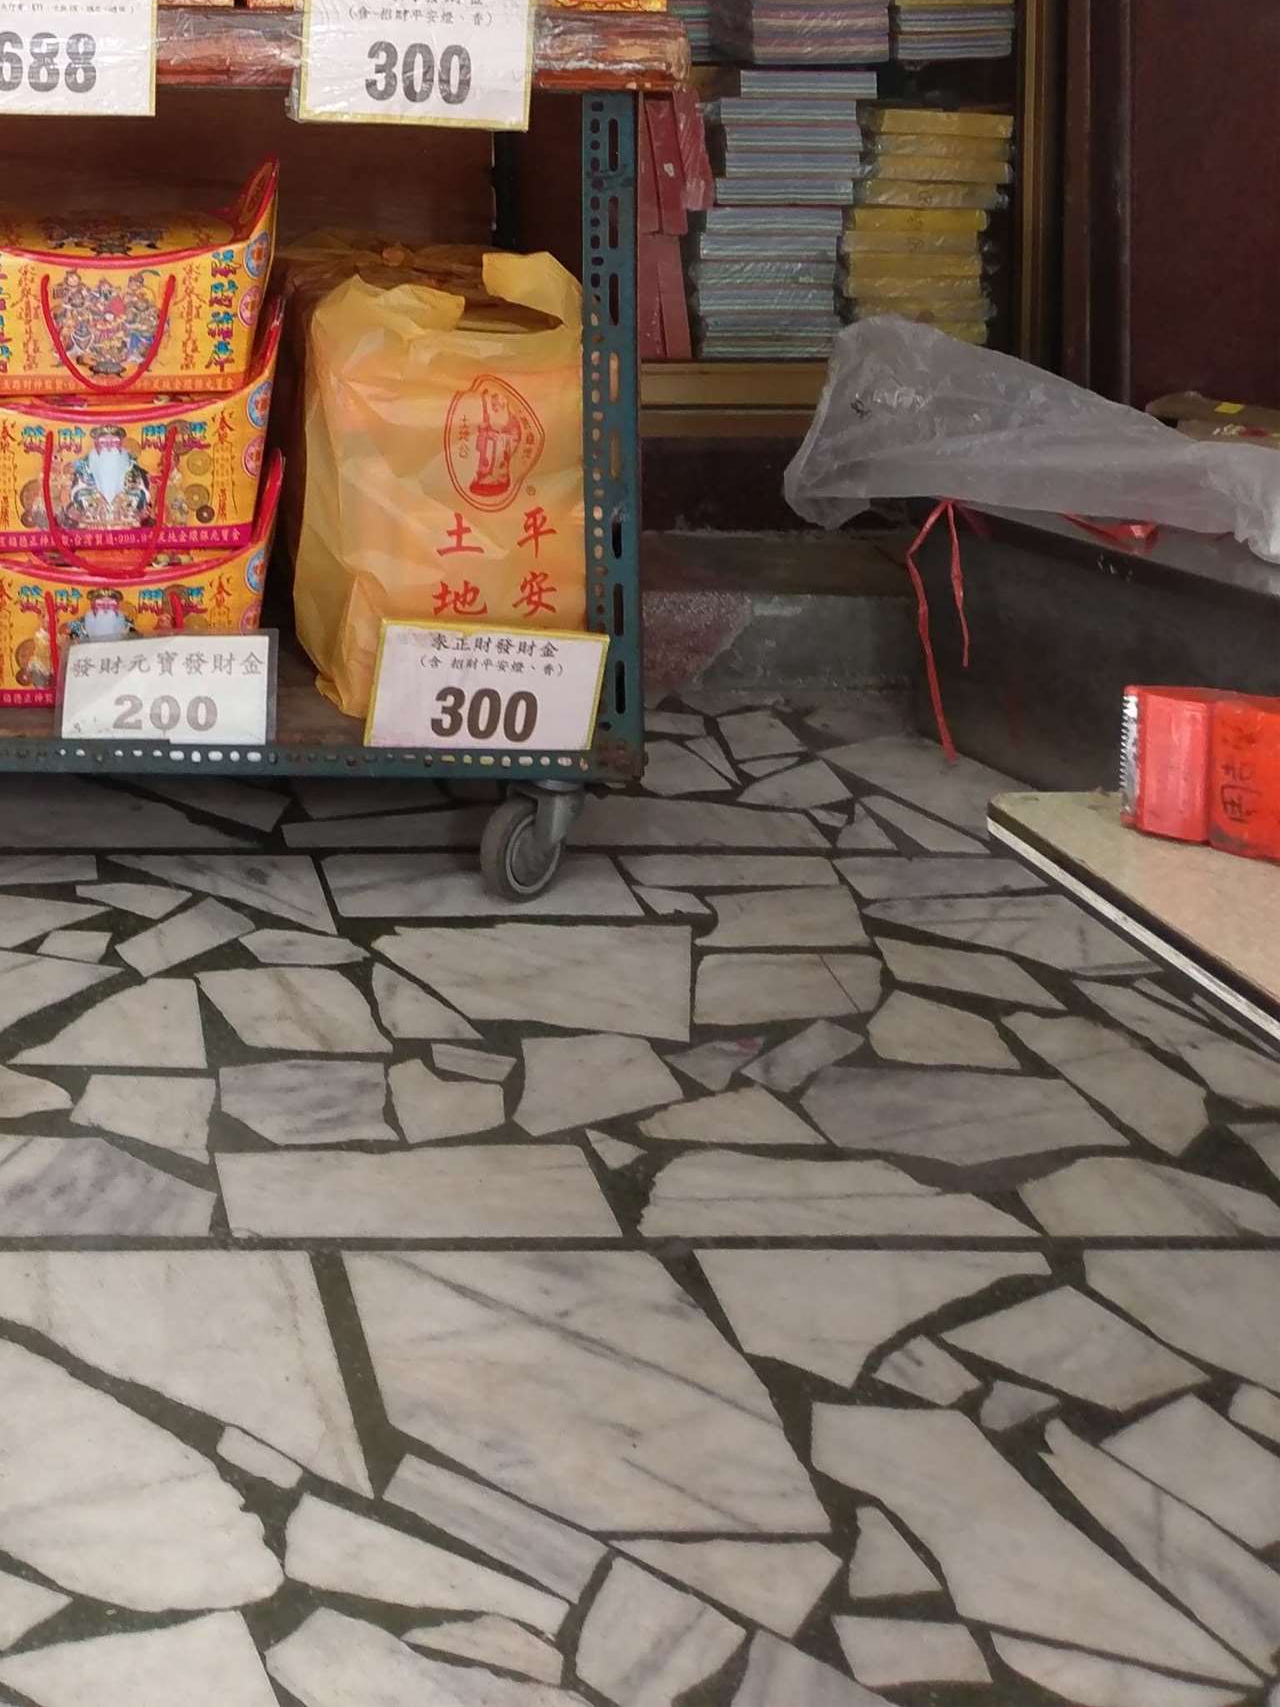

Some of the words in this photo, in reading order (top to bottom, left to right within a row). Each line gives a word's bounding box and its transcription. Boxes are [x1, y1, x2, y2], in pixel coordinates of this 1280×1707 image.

[365, 40, 472, 105] 300
[431, 512, 488, 616] 土地
[511, 505, 558, 618] 平安
[71, 648, 265, 679] 發財元寶發財金
[429, 633, 559, 659] 求正財發財金
[113, 694, 219, 732] 200
[431, 685, 539, 743] 300
